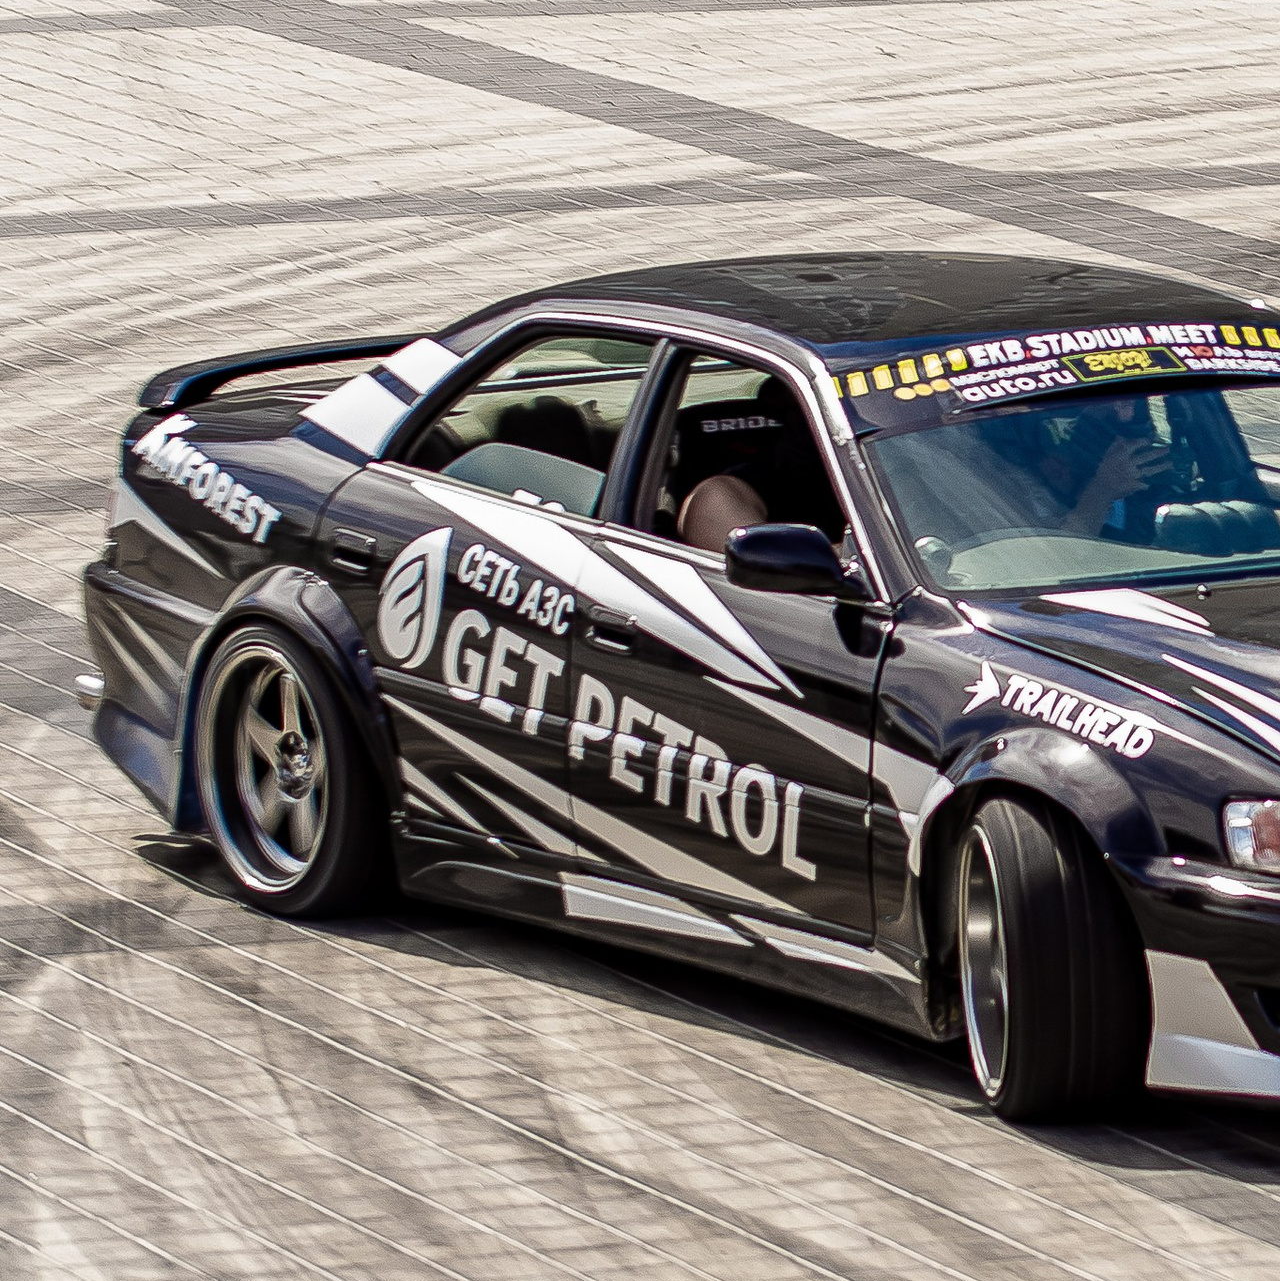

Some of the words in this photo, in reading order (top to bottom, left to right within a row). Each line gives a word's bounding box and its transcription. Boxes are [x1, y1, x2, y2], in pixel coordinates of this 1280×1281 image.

[962, 369, 1077, 402] auto.ru
[457, 543, 521, 607] СЕТЬ
[516, 579, 576, 636] АЗС
[442, 608, 566, 736] GET
[568, 673, 817, 882] PETROL
[1001, 674, 1155, 759] TRAILHEAD
